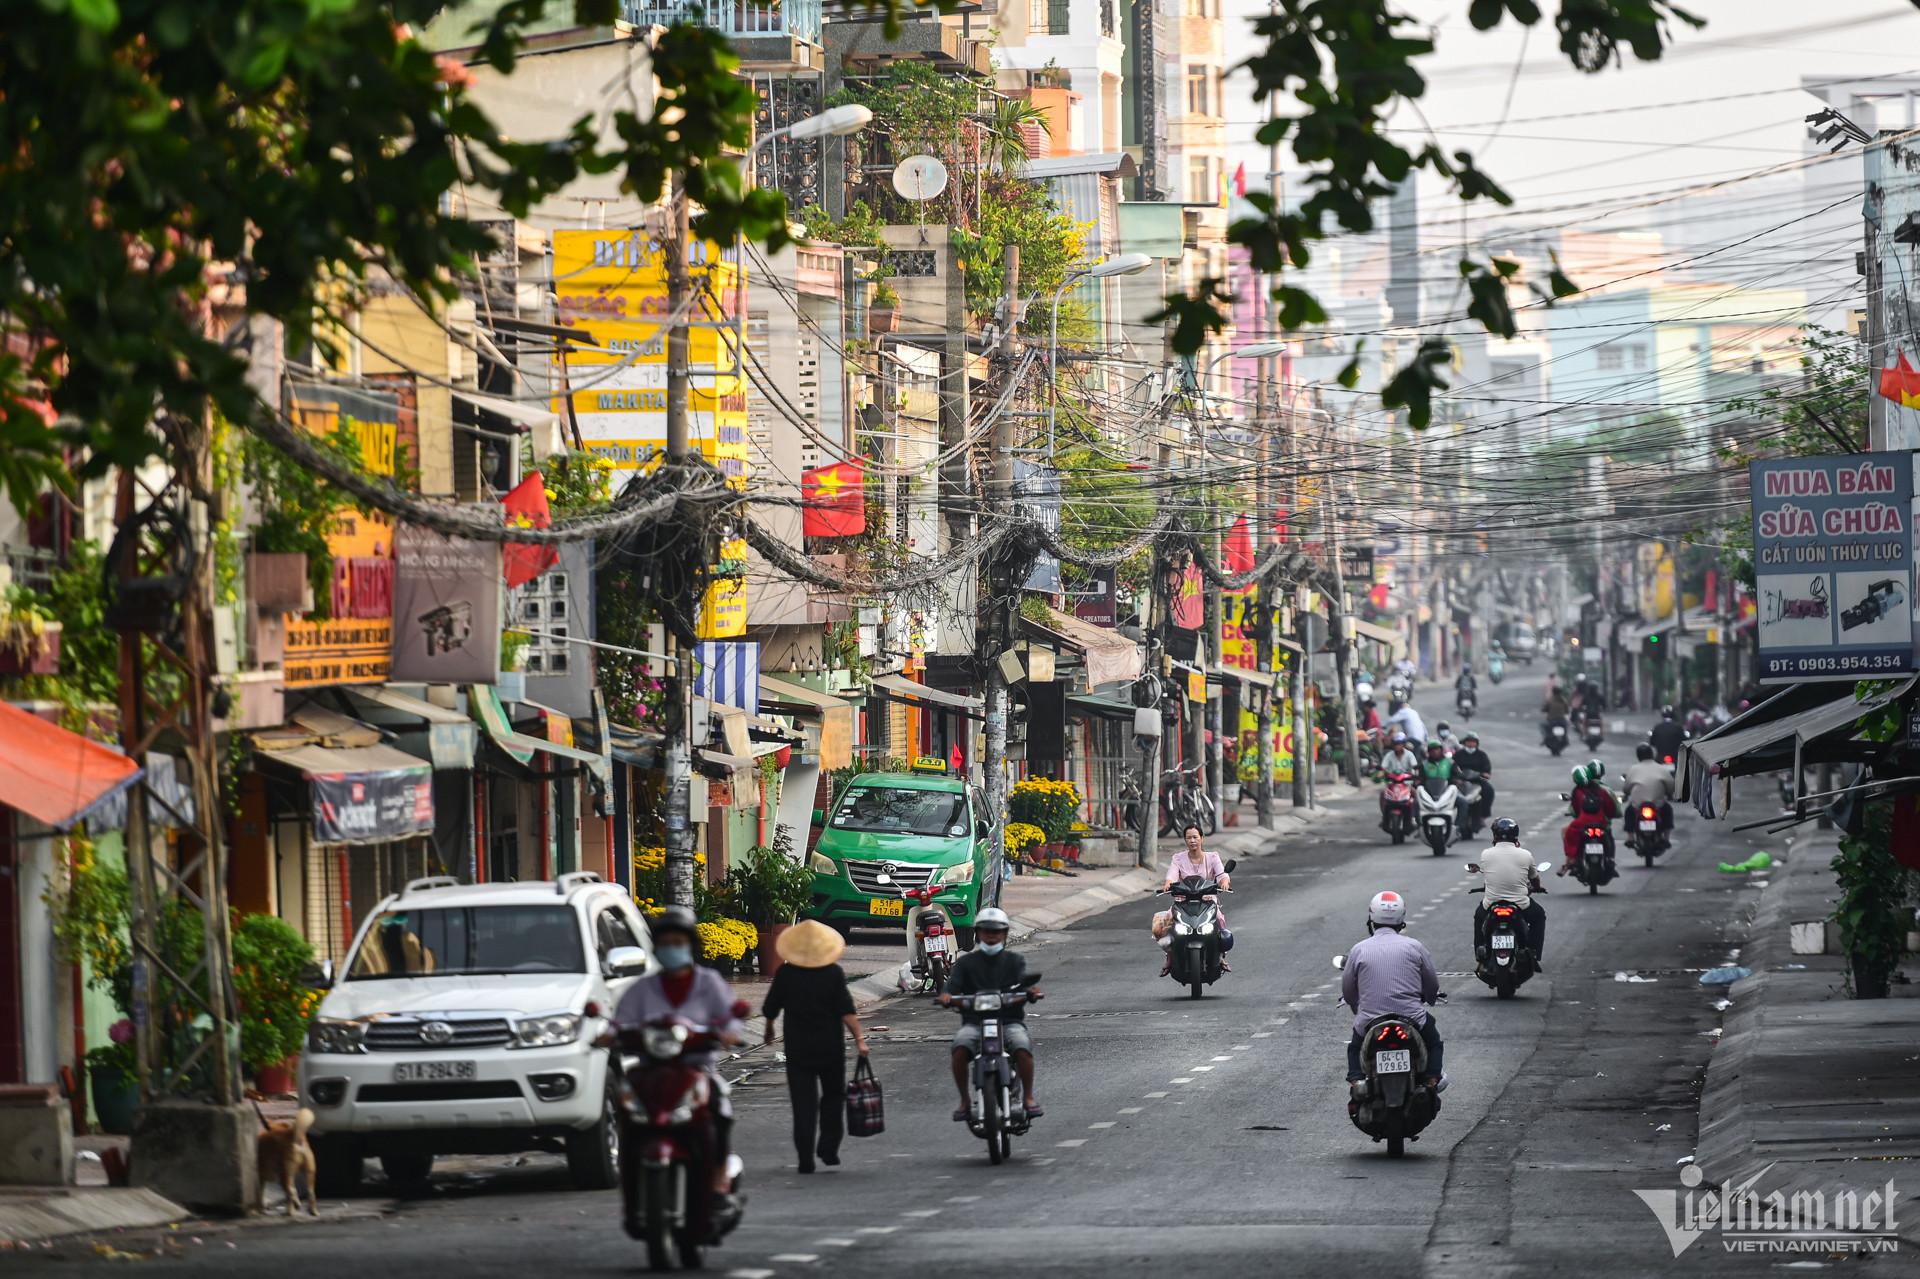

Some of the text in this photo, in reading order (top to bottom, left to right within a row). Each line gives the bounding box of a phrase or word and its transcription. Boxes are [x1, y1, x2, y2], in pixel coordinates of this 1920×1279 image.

[598, 391, 667, 410] MAKITA
[1765, 461, 1895, 497] MUA BÁN
[1759, 502, 1818, 537] SỬA
[1822, 502, 1903, 534] CHỮA
[1761, 541, 1902, 564] CẮT UỐN THỦY LỰC
[1770, 656, 1901, 671] ĐT: 0903.954.354
[873, 907, 899, 915] 217.68
[1381, 1051, 1404, 1062] 64-C1
[1379, 1061, 1408, 1071] 129.65
